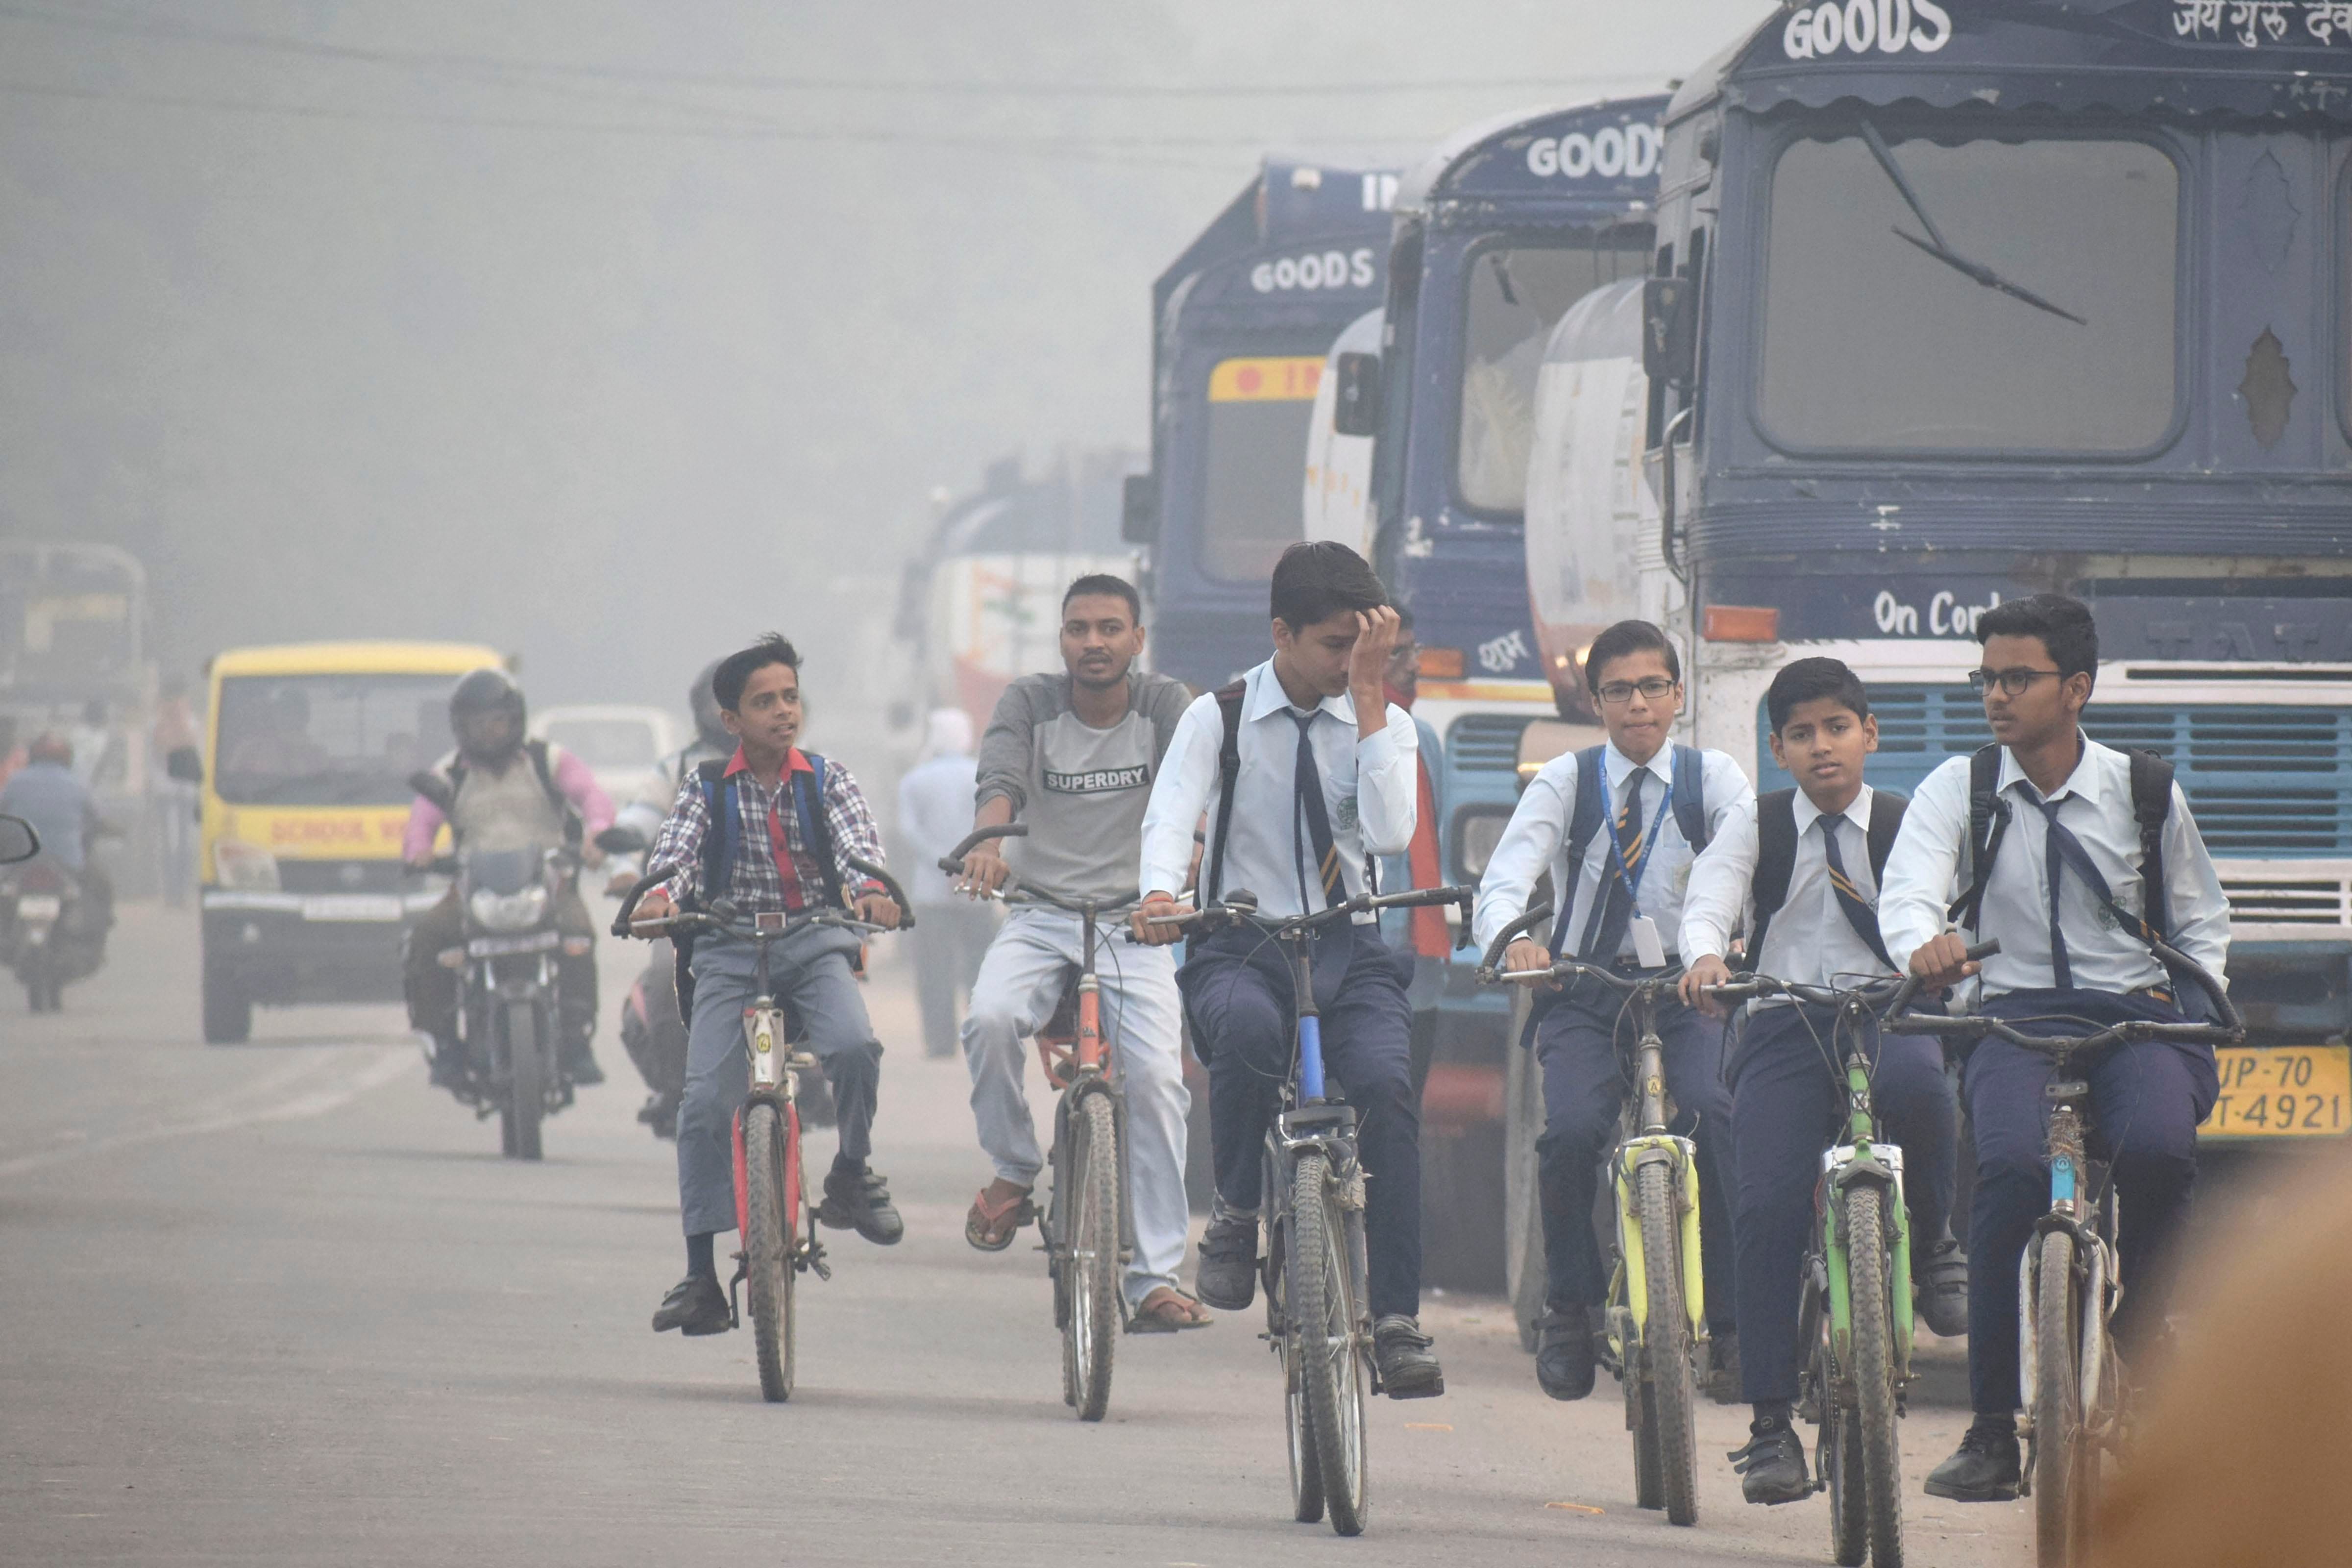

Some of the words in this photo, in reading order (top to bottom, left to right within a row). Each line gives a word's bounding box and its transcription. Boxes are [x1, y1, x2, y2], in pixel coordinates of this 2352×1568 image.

[1784, 0, 1952, 59] GOODS
[1251, 248, 1374, 292] GOODS
[1874, 590, 1918, 635] On
[1048, 767, 1144, 789] SUPERDRY
